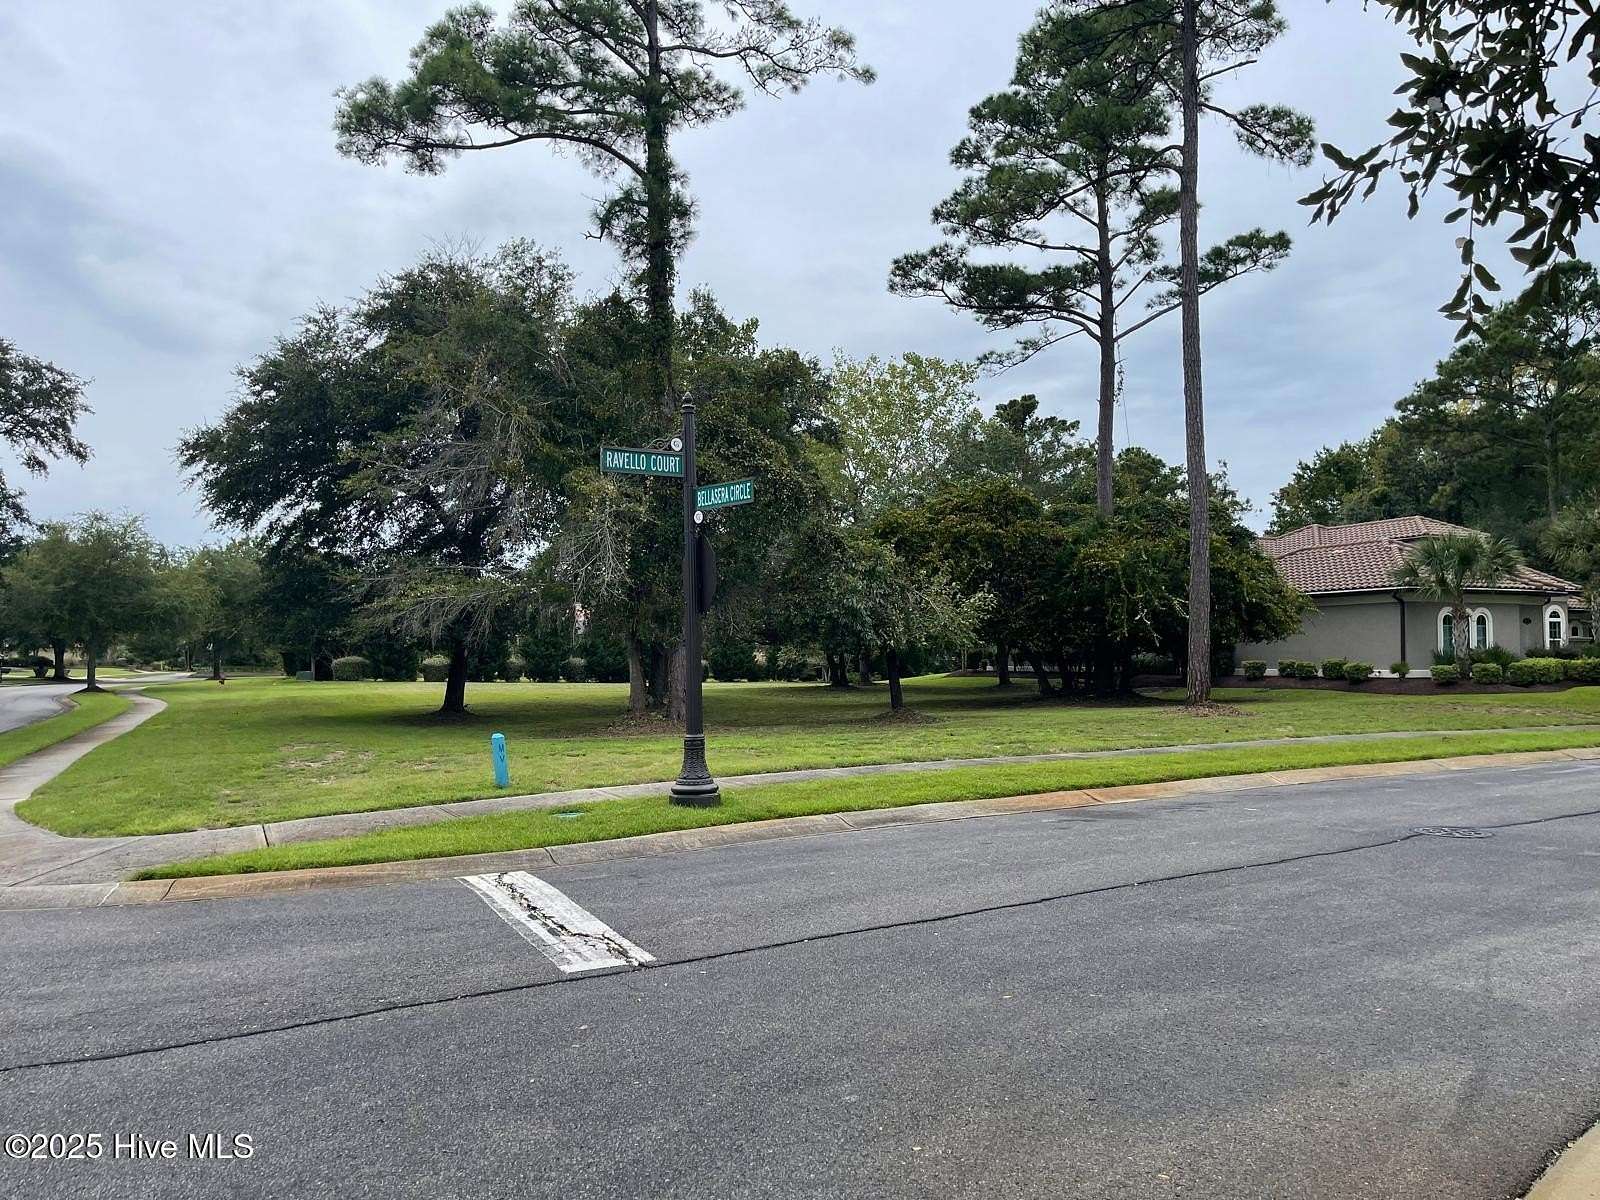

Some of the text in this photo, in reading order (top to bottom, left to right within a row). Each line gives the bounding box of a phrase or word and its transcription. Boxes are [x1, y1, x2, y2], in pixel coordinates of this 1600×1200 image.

[606, 451, 680, 473] RAVELLO COURT
[697, 482, 751, 507] BELLASERA CIRCLE
